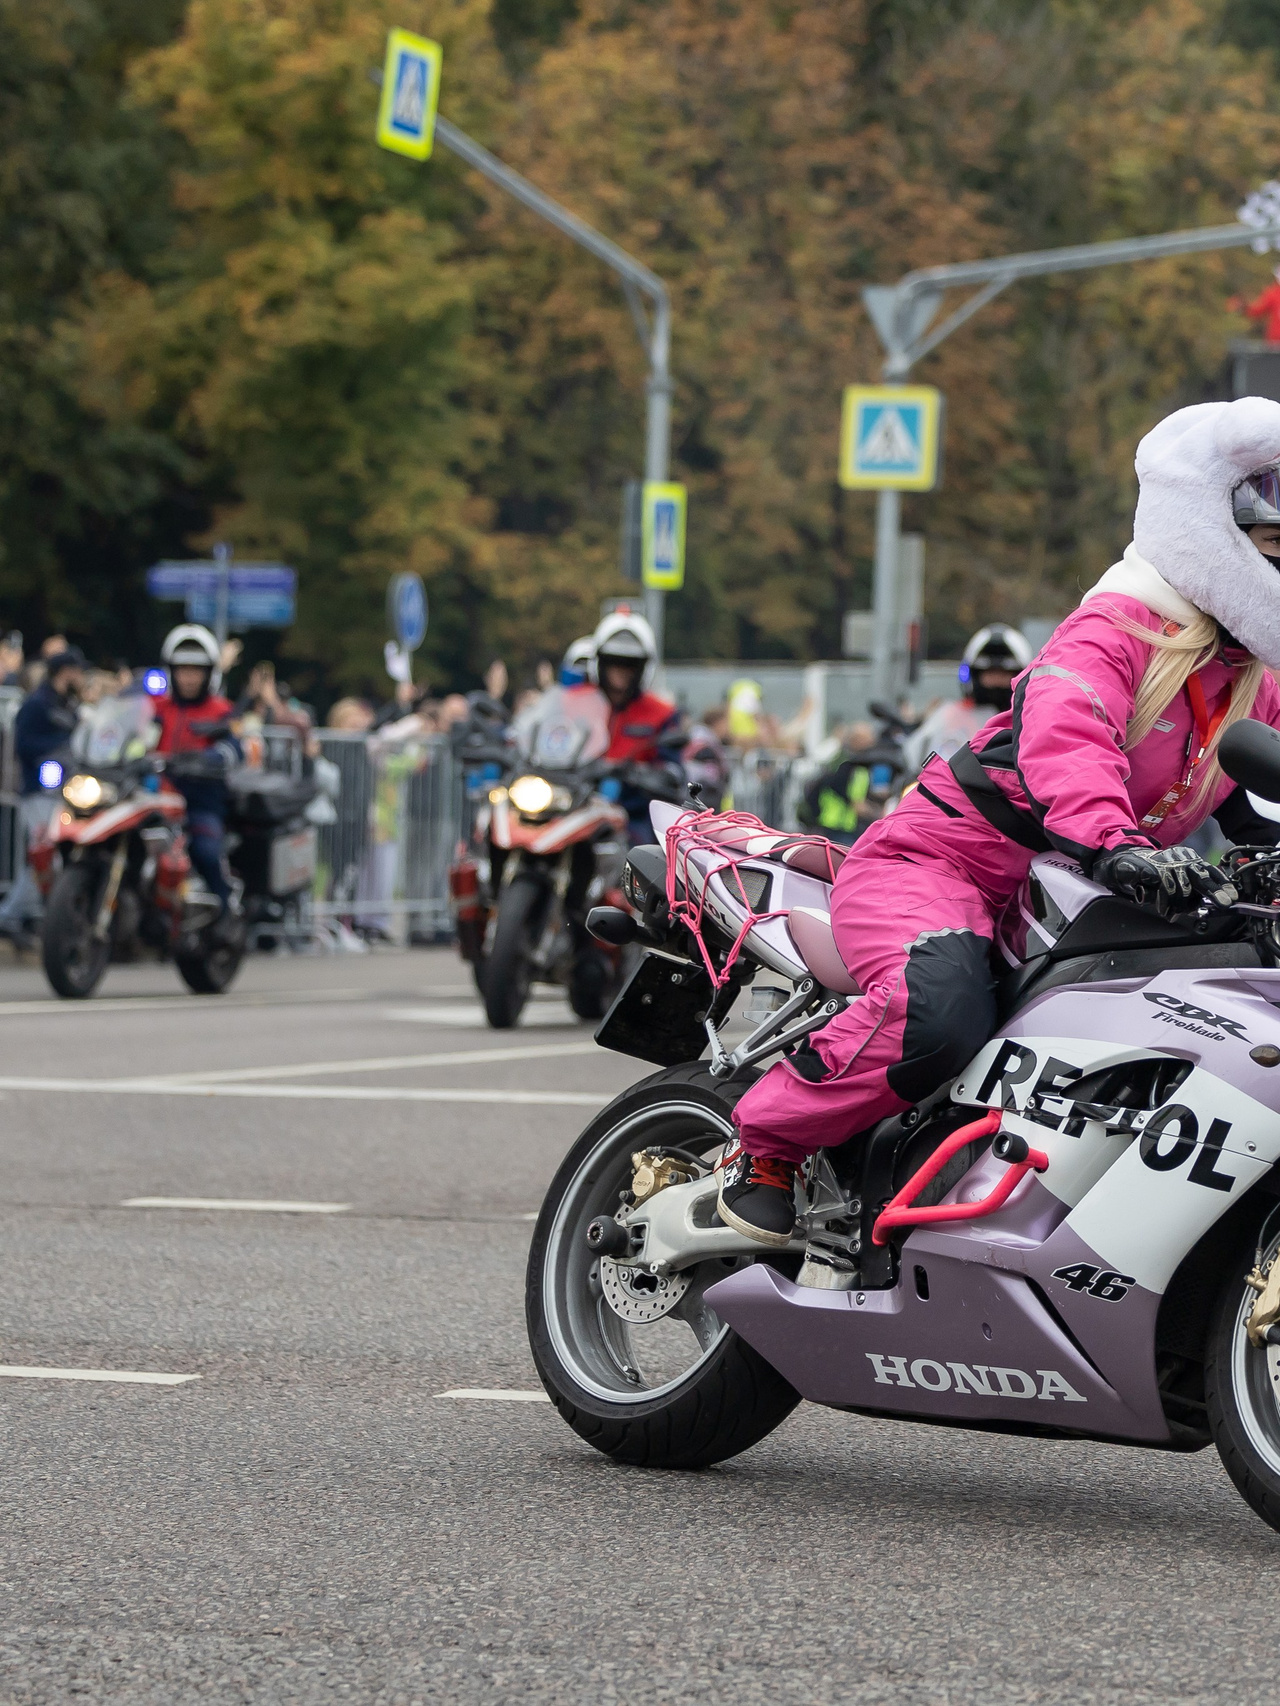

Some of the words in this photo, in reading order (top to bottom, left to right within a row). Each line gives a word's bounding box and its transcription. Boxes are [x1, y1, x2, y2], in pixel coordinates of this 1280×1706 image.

[1043, 859, 1085, 876] HOND
[1142, 992, 1253, 1044] CBR
[1151, 1011, 1226, 1041] Fireblade
[1050, 1262, 1137, 1303] 46
[865, 1352, 1088, 1402] HONDA
